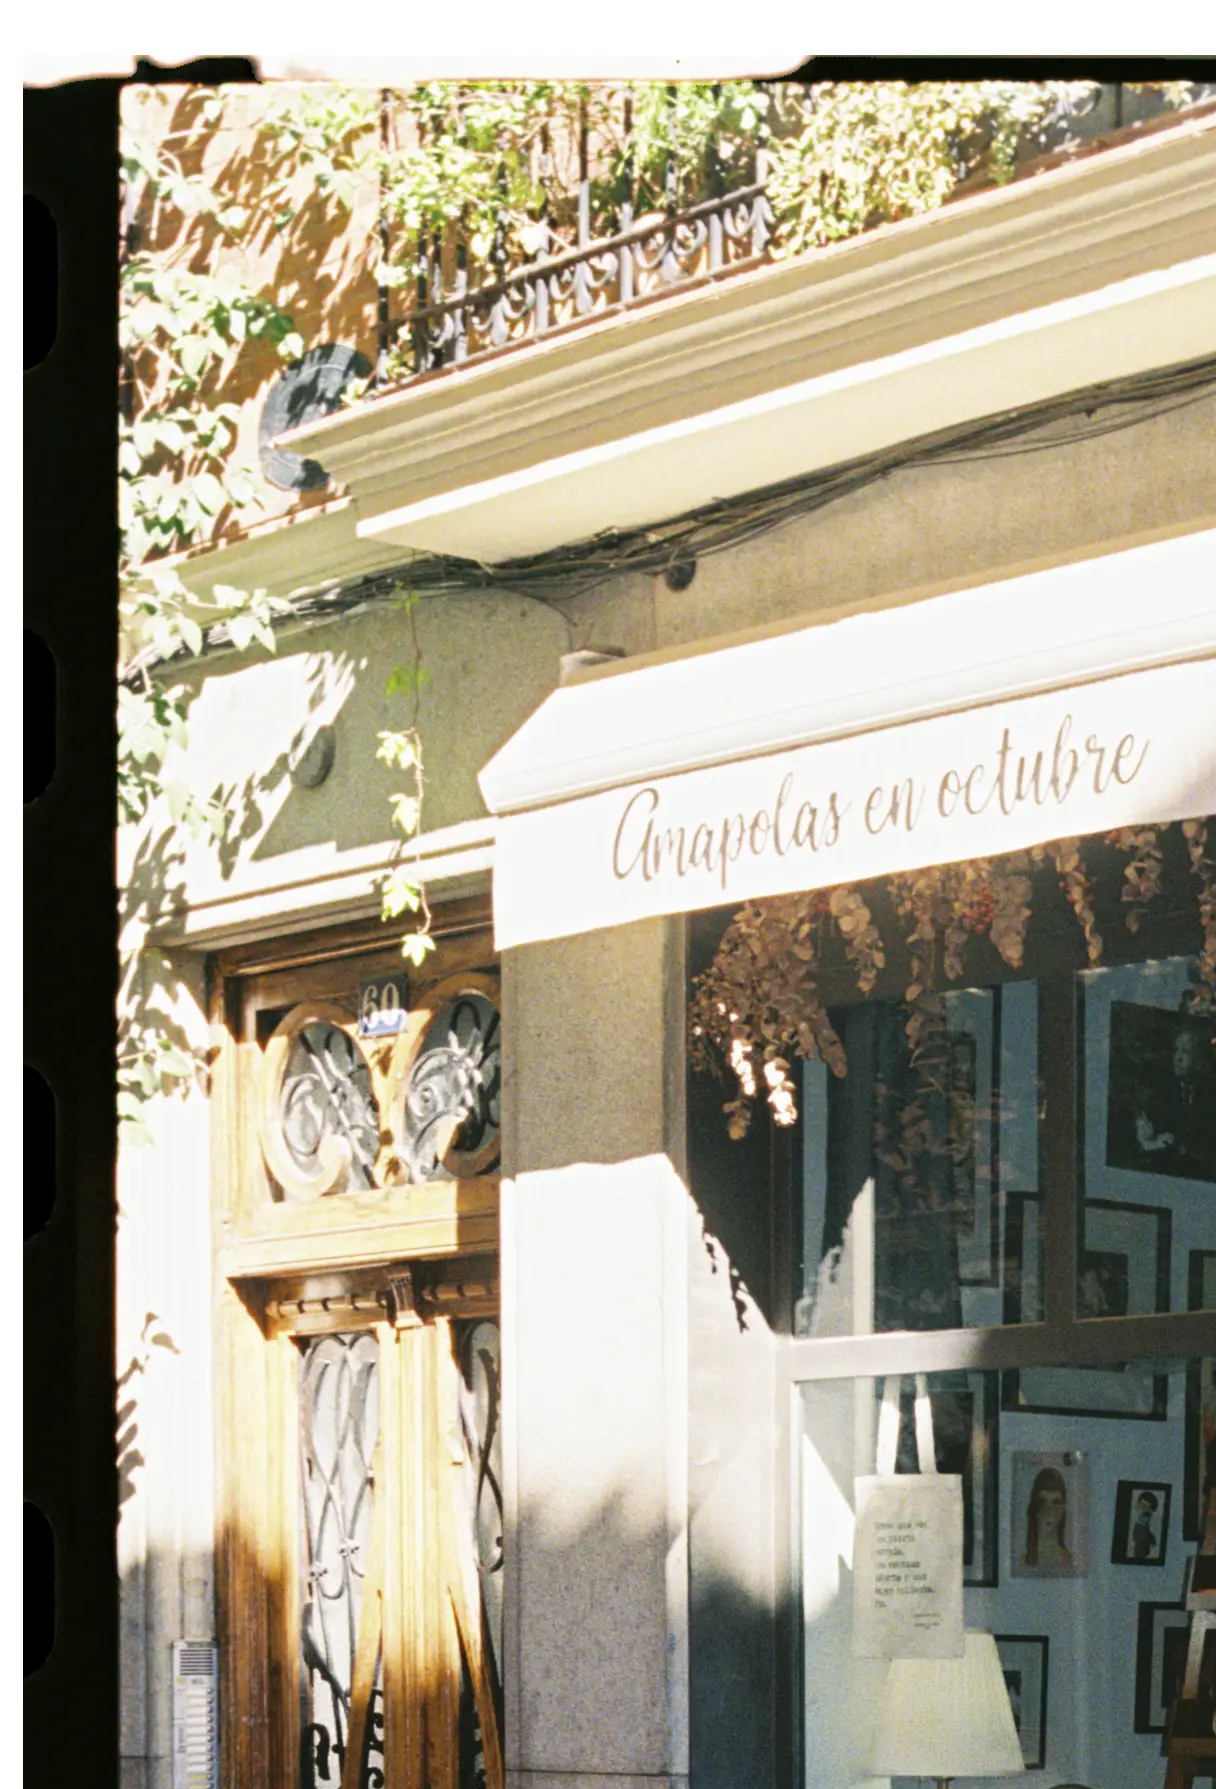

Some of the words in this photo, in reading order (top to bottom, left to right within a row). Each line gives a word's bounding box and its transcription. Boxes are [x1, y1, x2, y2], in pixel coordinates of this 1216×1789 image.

[612, 772, 848, 890] Amapolas
[863, 776, 923, 834] en
[937, 714, 1150, 817] octubre
[362, 982, 401, 1030] 60
